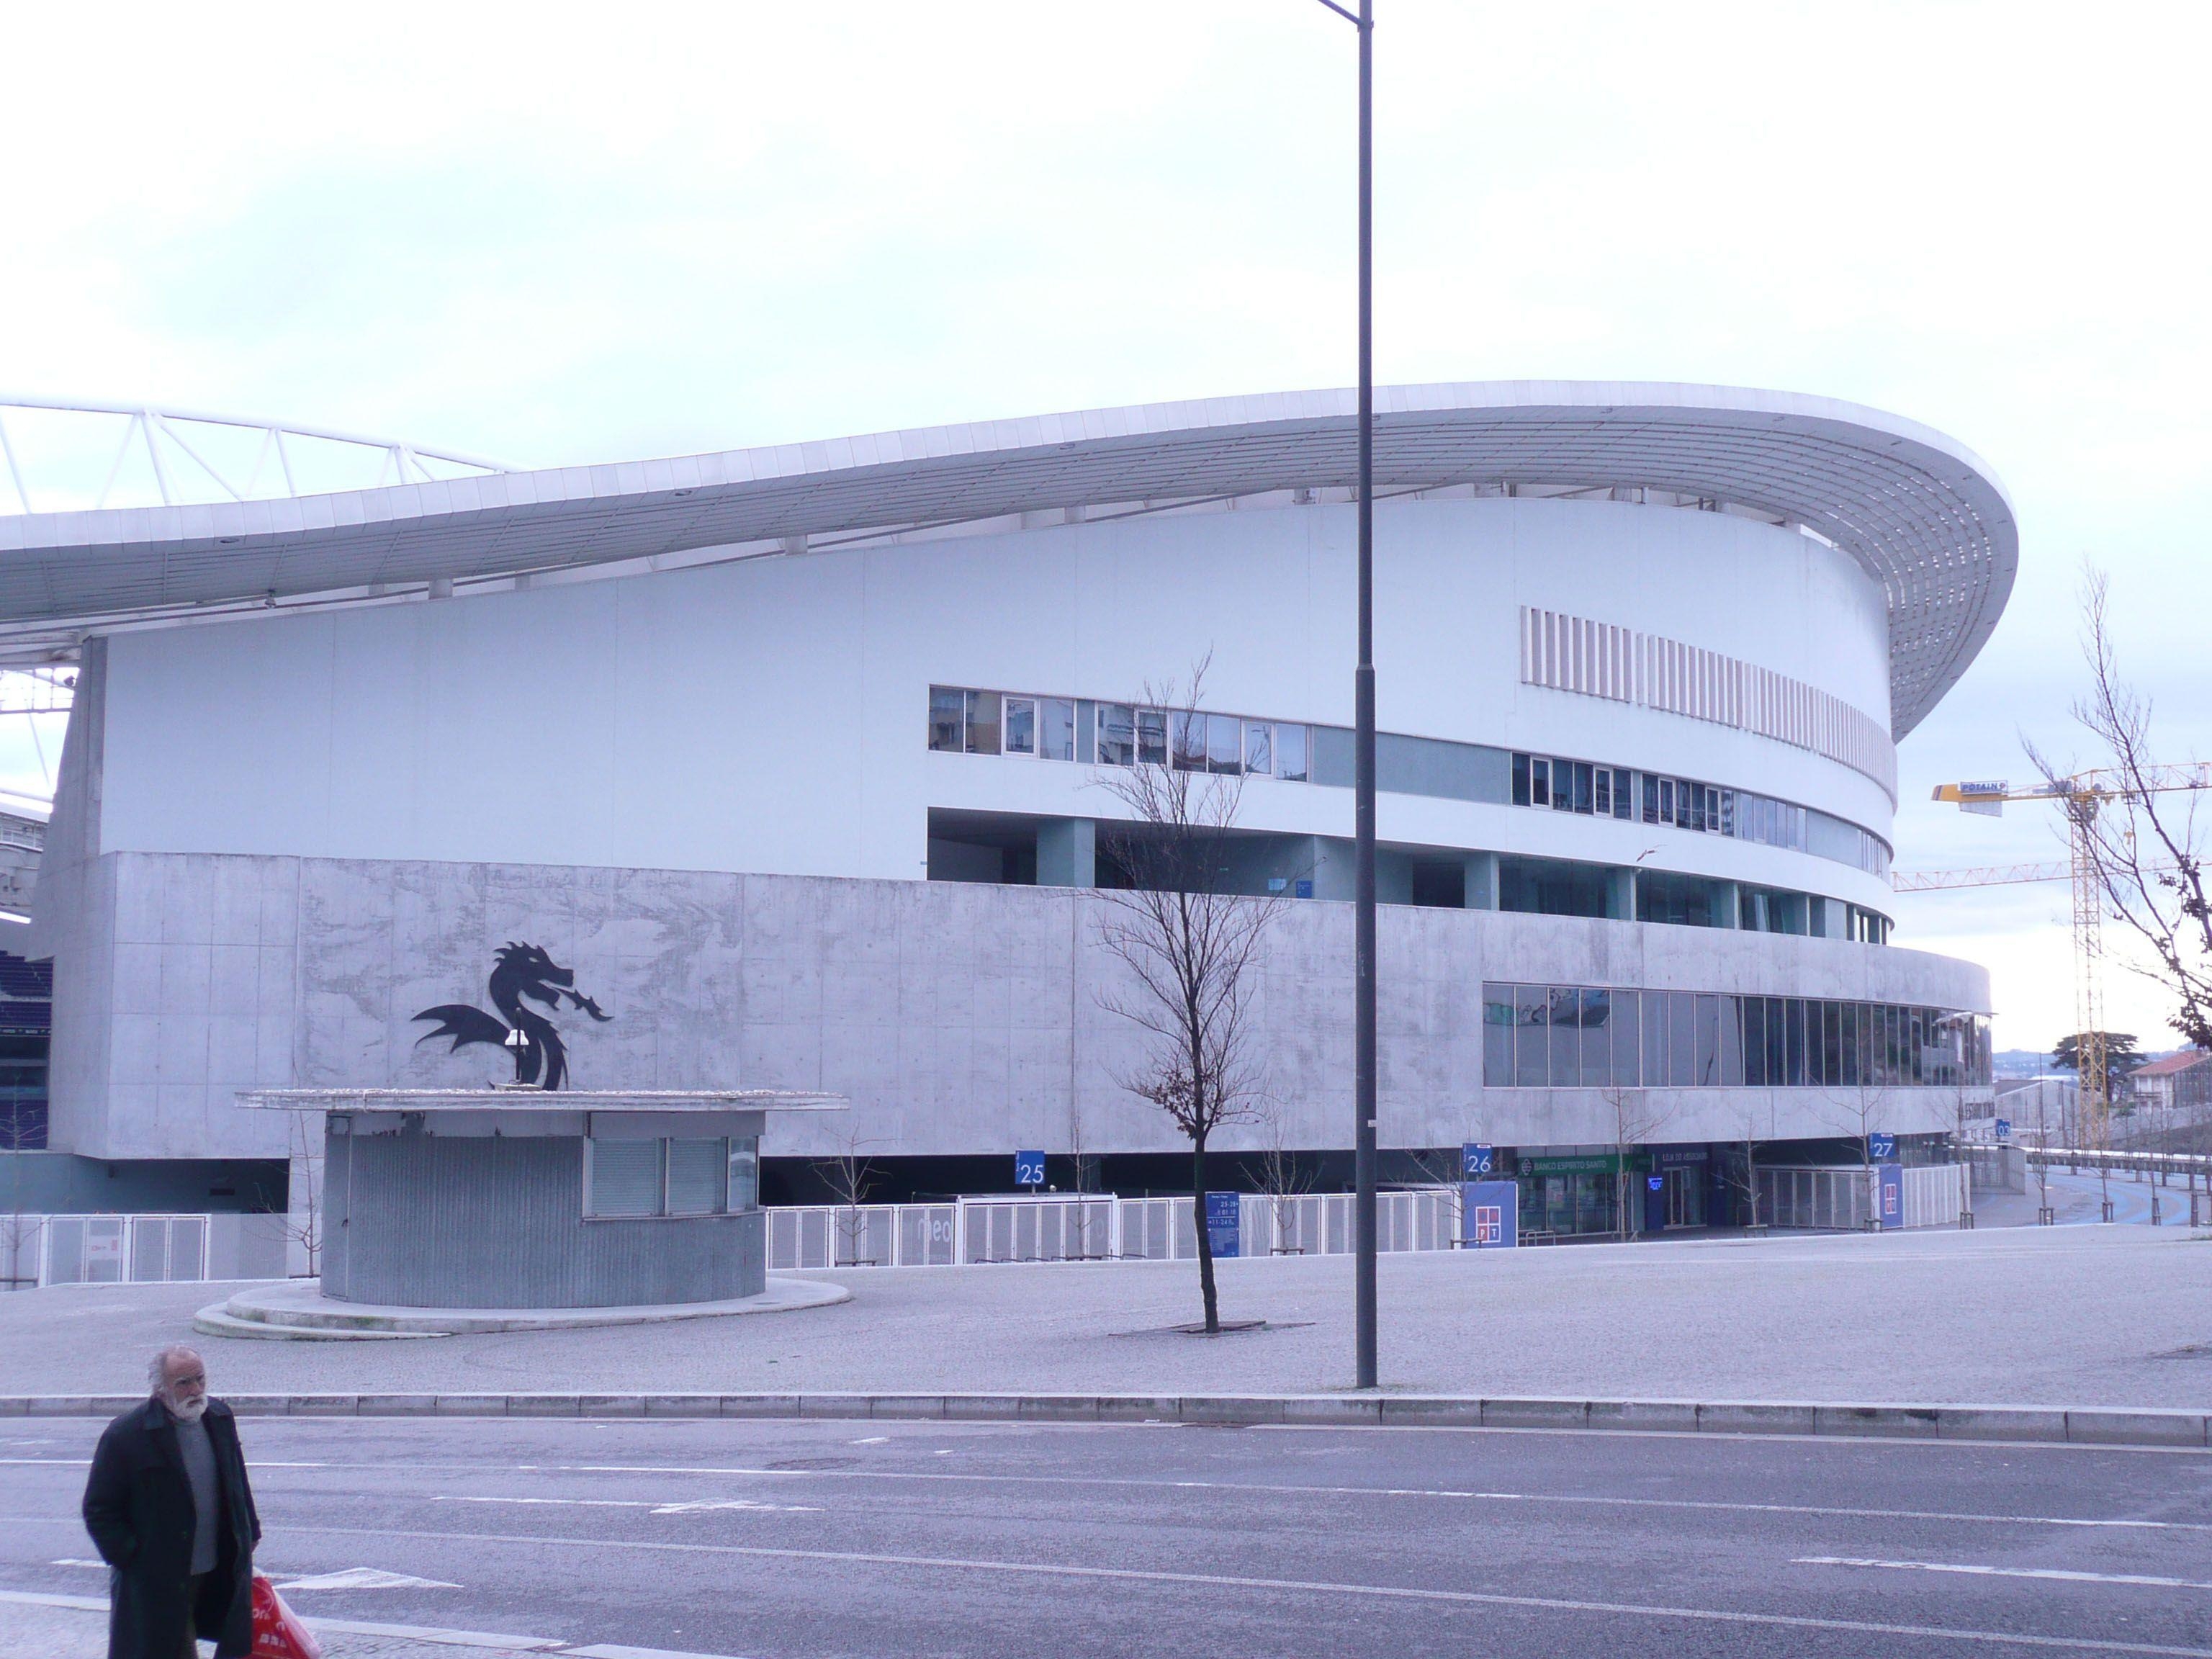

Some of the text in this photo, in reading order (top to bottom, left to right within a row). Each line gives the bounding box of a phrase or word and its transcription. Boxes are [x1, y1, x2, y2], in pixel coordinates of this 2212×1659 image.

[1998, 1125, 2010, 1136] 03
[1874, 1143, 1892, 1156] 27
[1468, 1155, 1491, 1172] 26
[1534, 1162, 1556, 1171] BANCO
[1586, 1159, 1607, 1169] SANTO
[1020, 1164, 1043, 1183] 25
